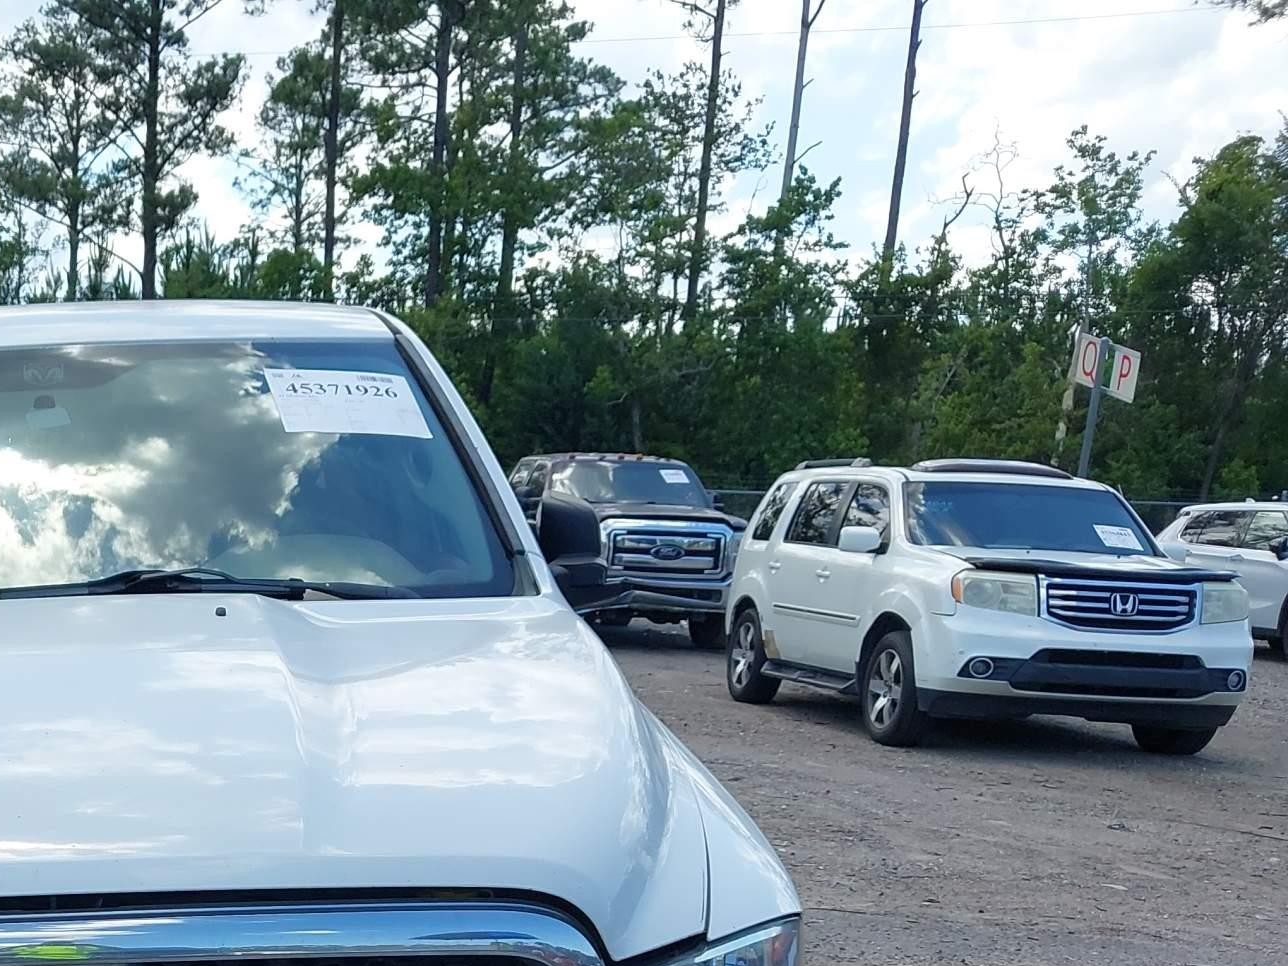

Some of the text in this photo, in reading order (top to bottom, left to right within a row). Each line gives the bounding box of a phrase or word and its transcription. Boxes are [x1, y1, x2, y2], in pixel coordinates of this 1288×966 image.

[1082, 341, 1096, 383] Q
[1117, 355, 1131, 390] P
[286, 383, 398, 398] 45371926
